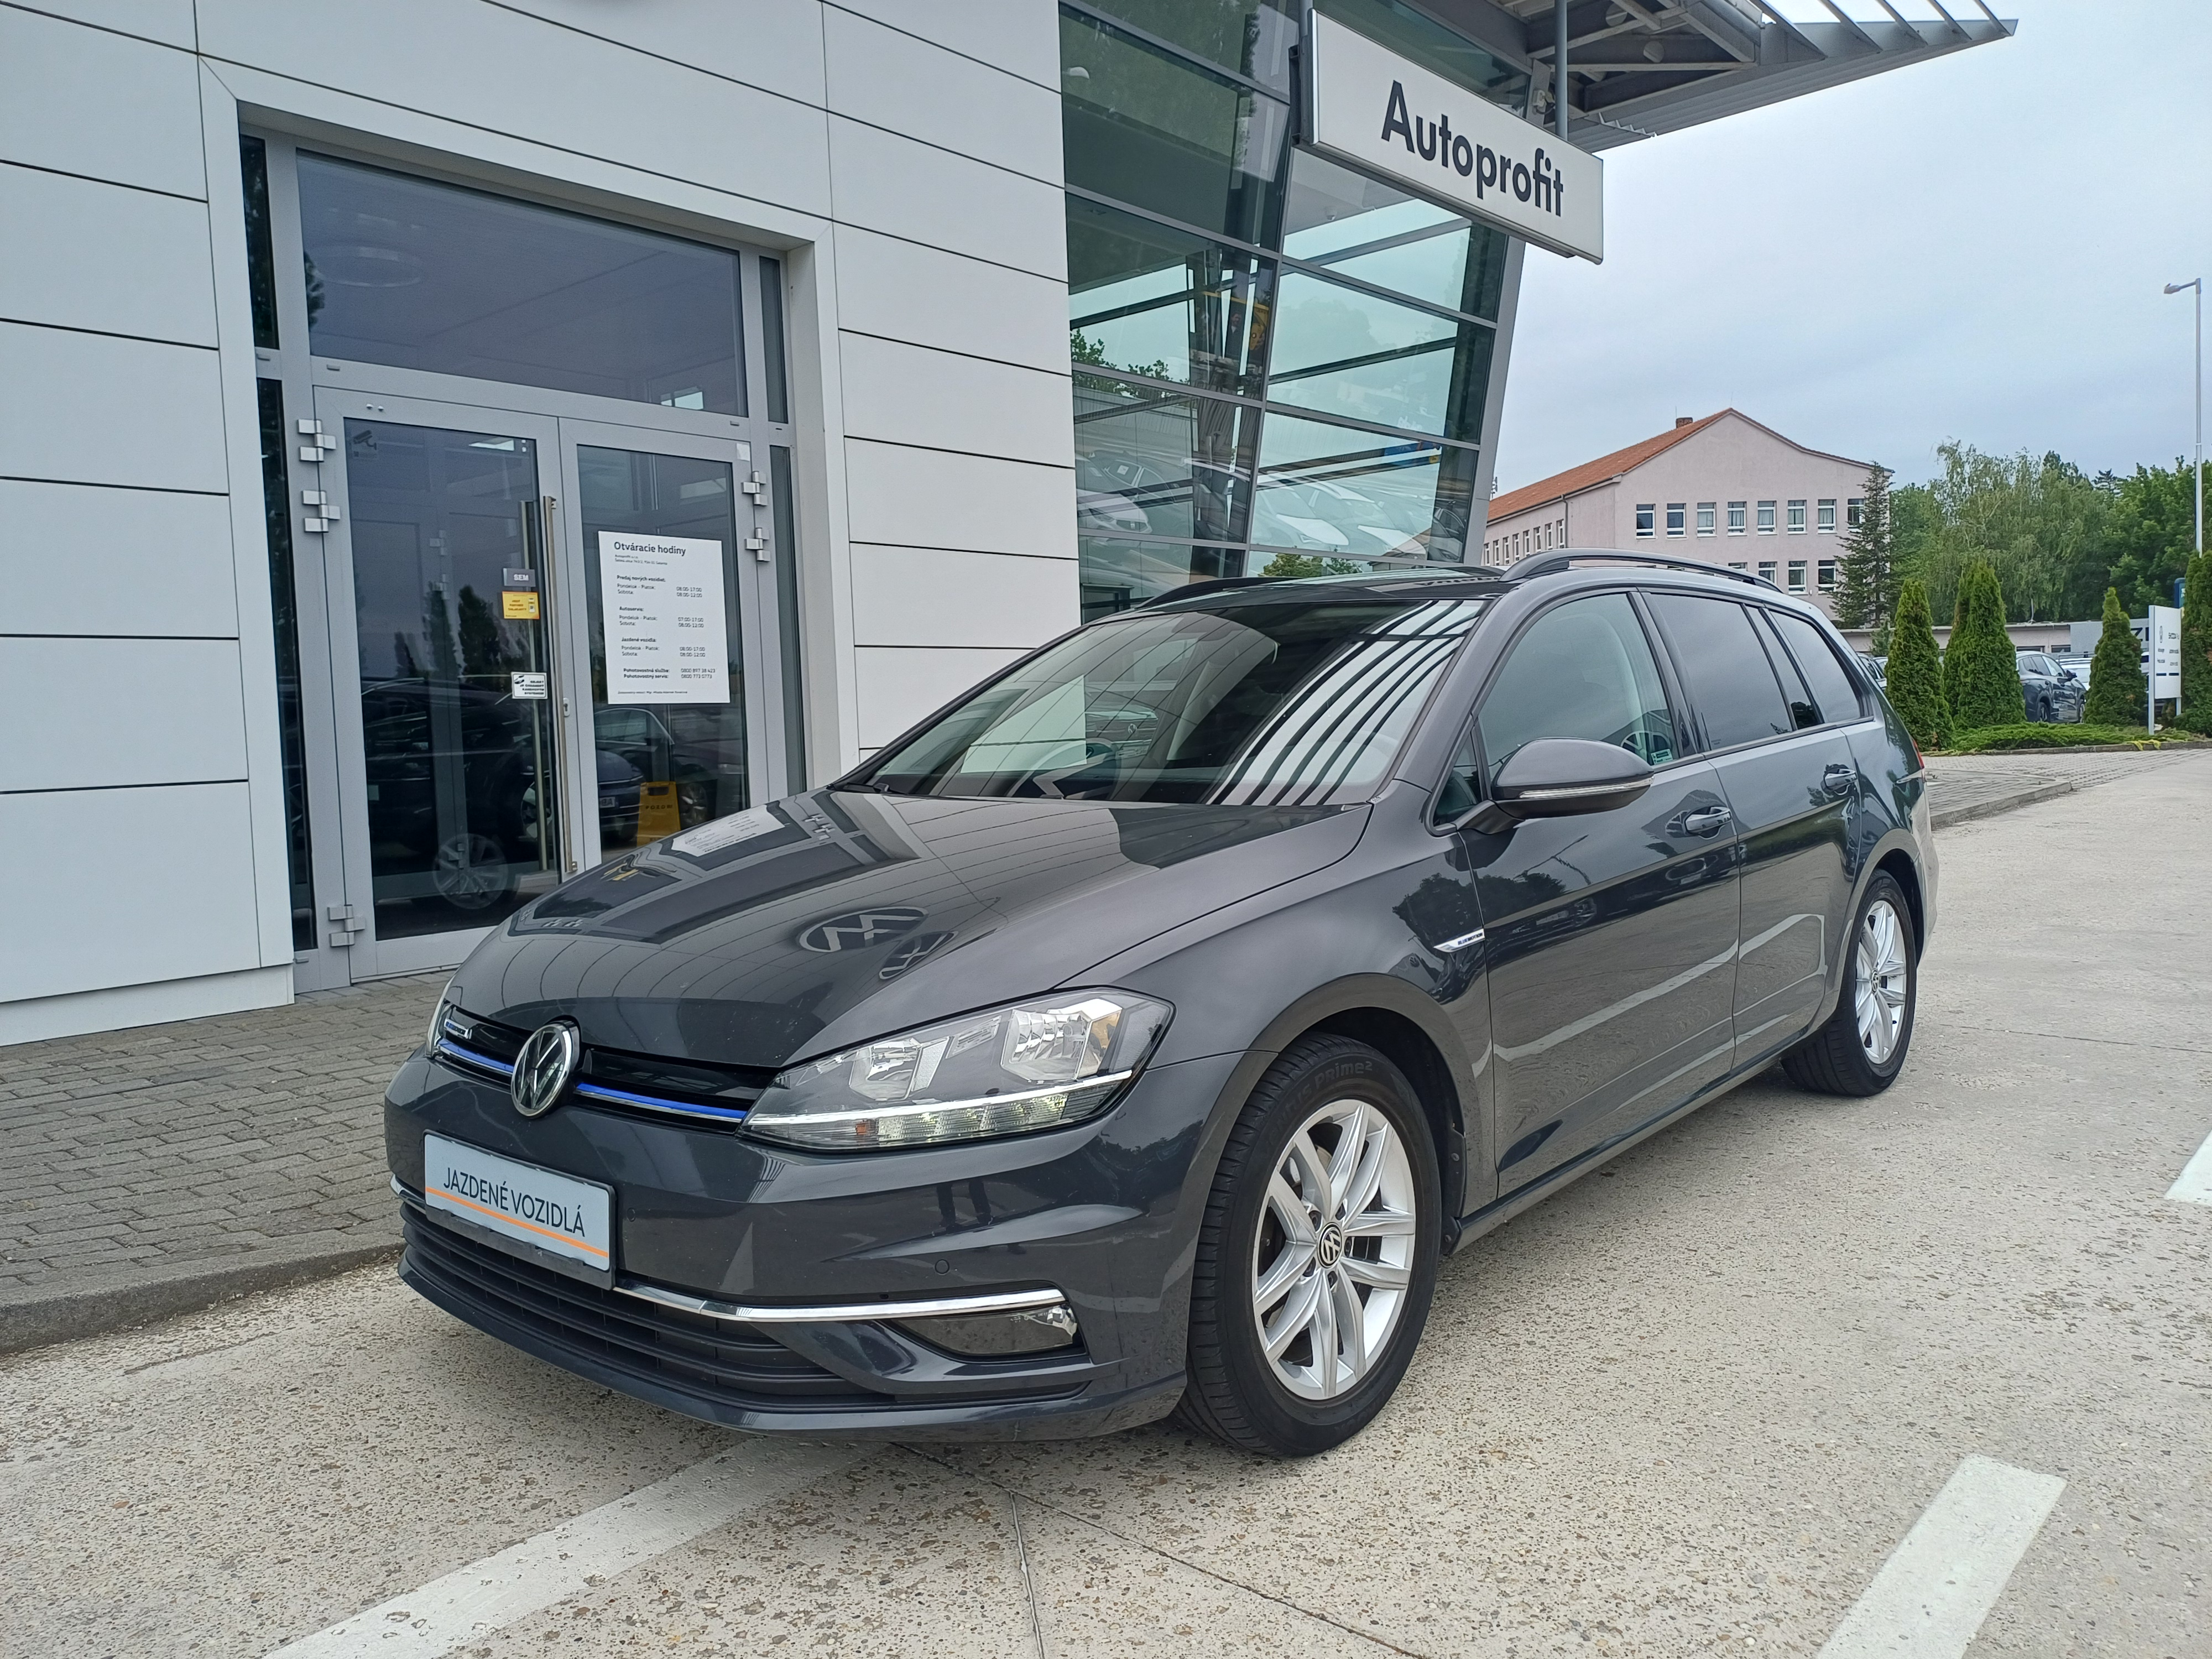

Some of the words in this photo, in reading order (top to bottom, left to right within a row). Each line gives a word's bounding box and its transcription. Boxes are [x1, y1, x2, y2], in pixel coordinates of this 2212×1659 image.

[1381, 80, 1563, 217] Autoprofit
[614, 541, 655, 552] Otváracie
[658, 545, 686, 556] hodiny
[444, 1167, 508, 1211] JAZDENÉ
[511, 1190, 585, 1237] VOZIDLÁ
